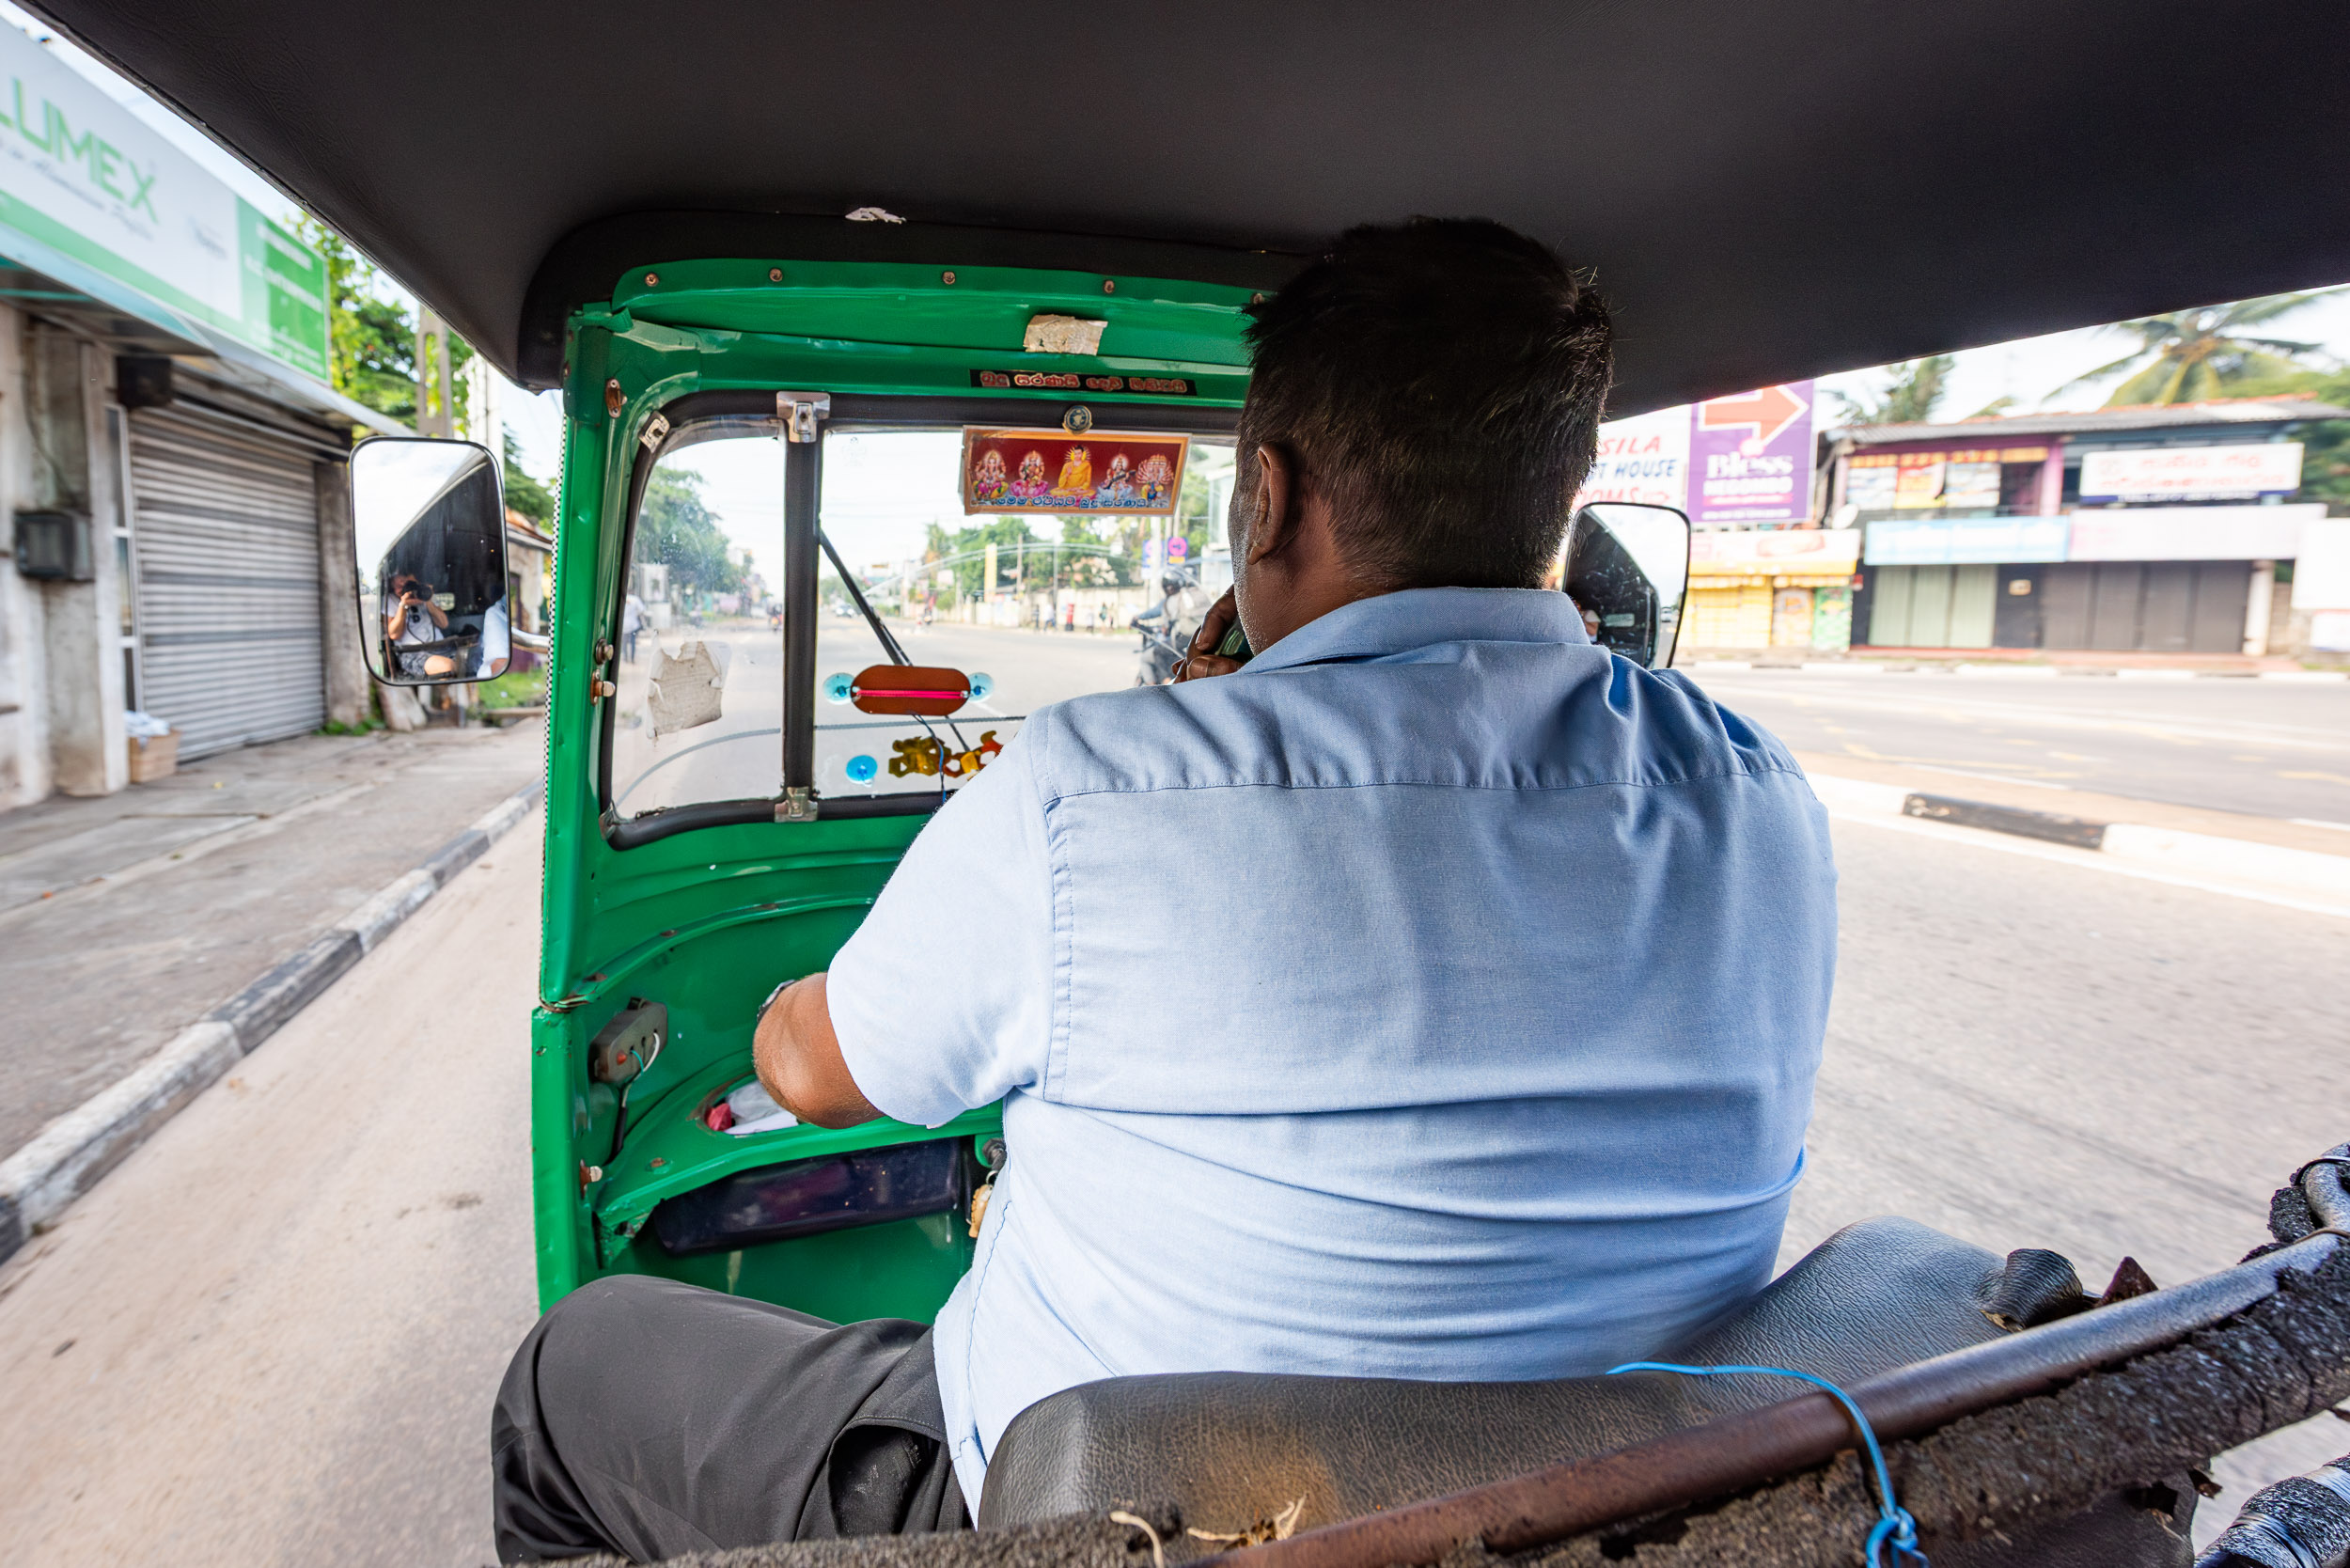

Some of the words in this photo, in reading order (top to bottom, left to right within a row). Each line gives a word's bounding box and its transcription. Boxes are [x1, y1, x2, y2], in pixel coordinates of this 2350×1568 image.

[0, 75, 159, 225] UMEX
[1597, 435, 1661, 456] SILA
[1615, 459, 1677, 479] HOUSE
